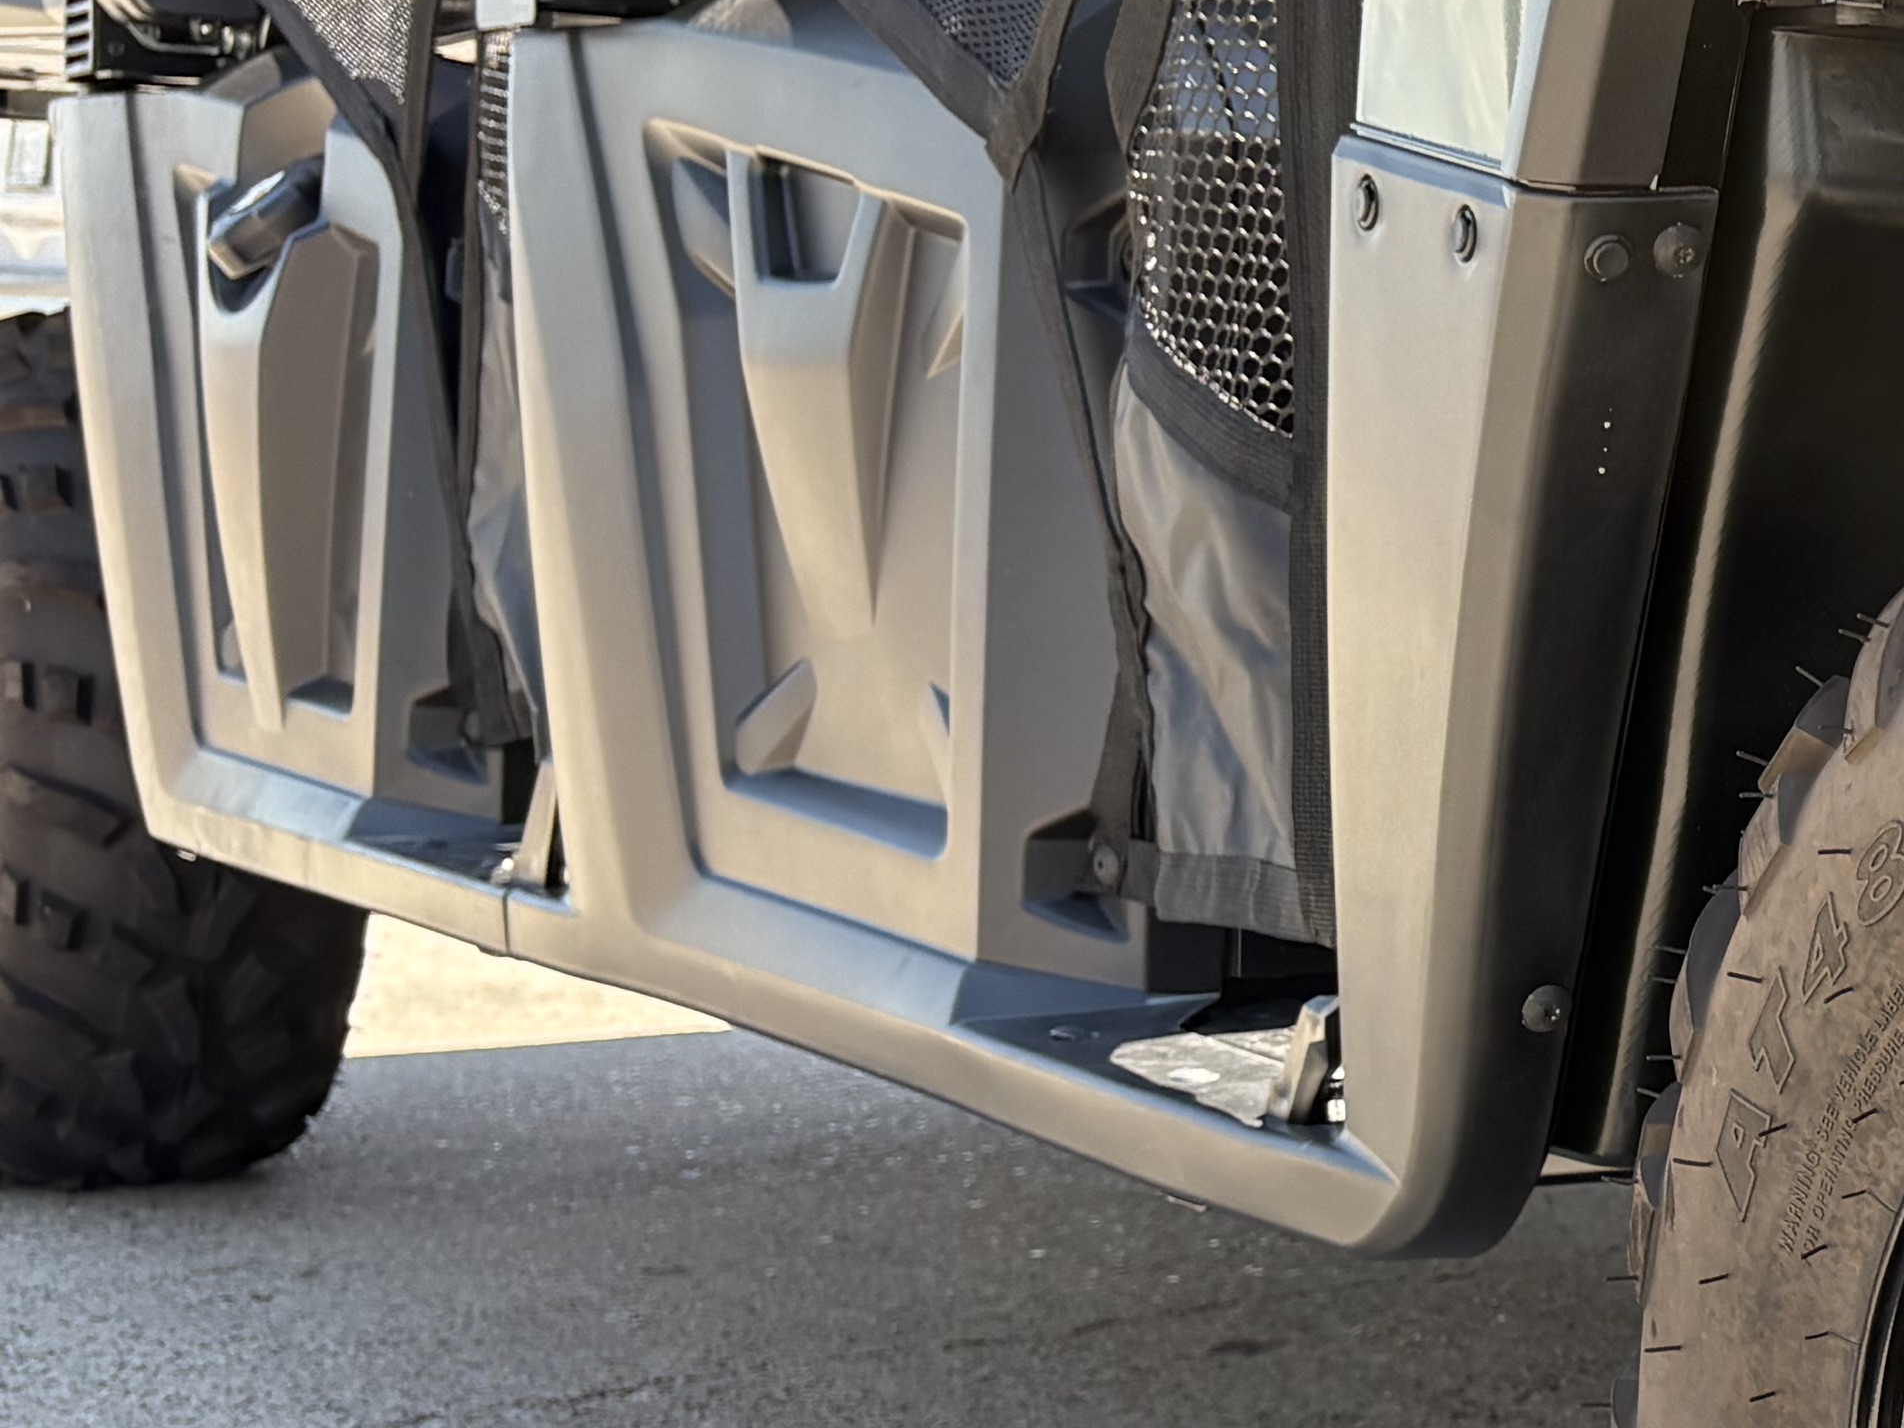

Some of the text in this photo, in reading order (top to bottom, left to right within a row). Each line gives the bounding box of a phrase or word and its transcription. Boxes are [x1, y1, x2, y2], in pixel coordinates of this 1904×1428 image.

[1816, 1100, 1839, 1143] SEE
[1834, 1024, 1875, 1105] VEHICLE
[1813, 1116, 1853, 1221] OPERATING
